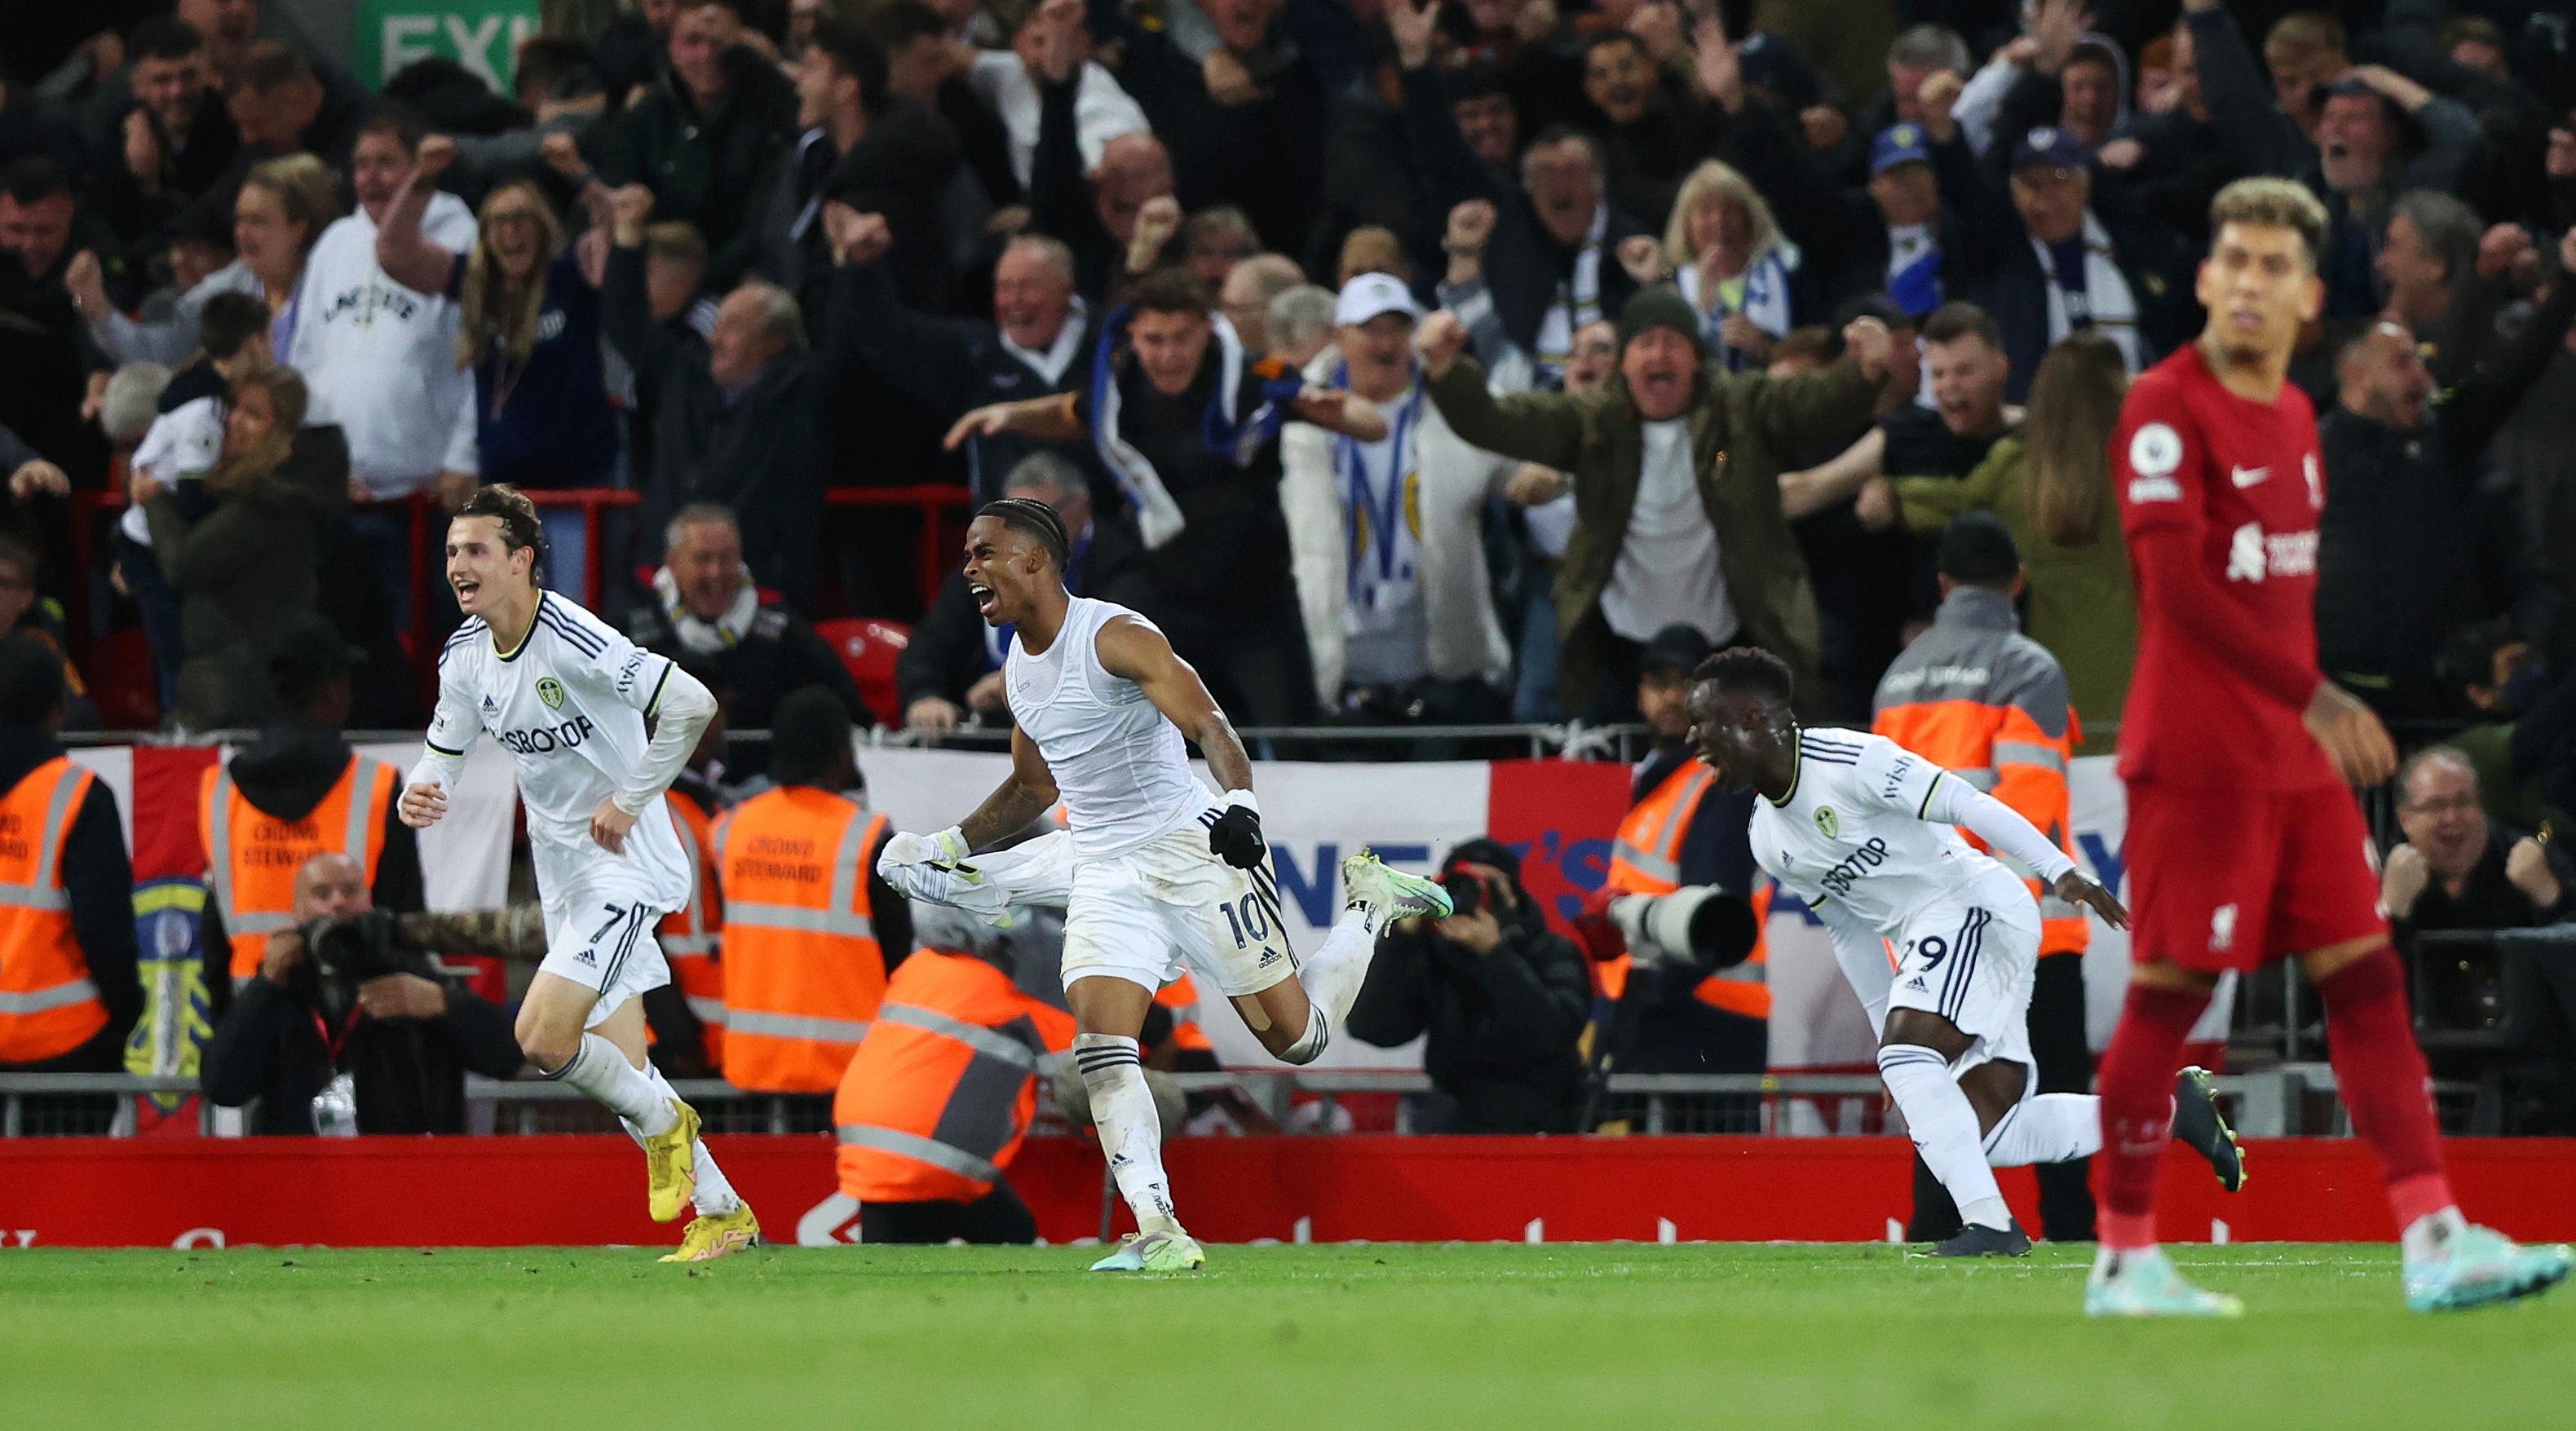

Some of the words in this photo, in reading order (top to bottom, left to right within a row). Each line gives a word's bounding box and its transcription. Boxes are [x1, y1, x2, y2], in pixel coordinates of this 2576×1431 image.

[616, 651, 647, 692] wish
[1884, 756, 1914, 798] wish
[736, 859, 824, 883] STEWARD
[590, 902, 627, 943] 7
[1220, 892, 1269, 950] 10
[1258, 953, 1283, 969] adidas
